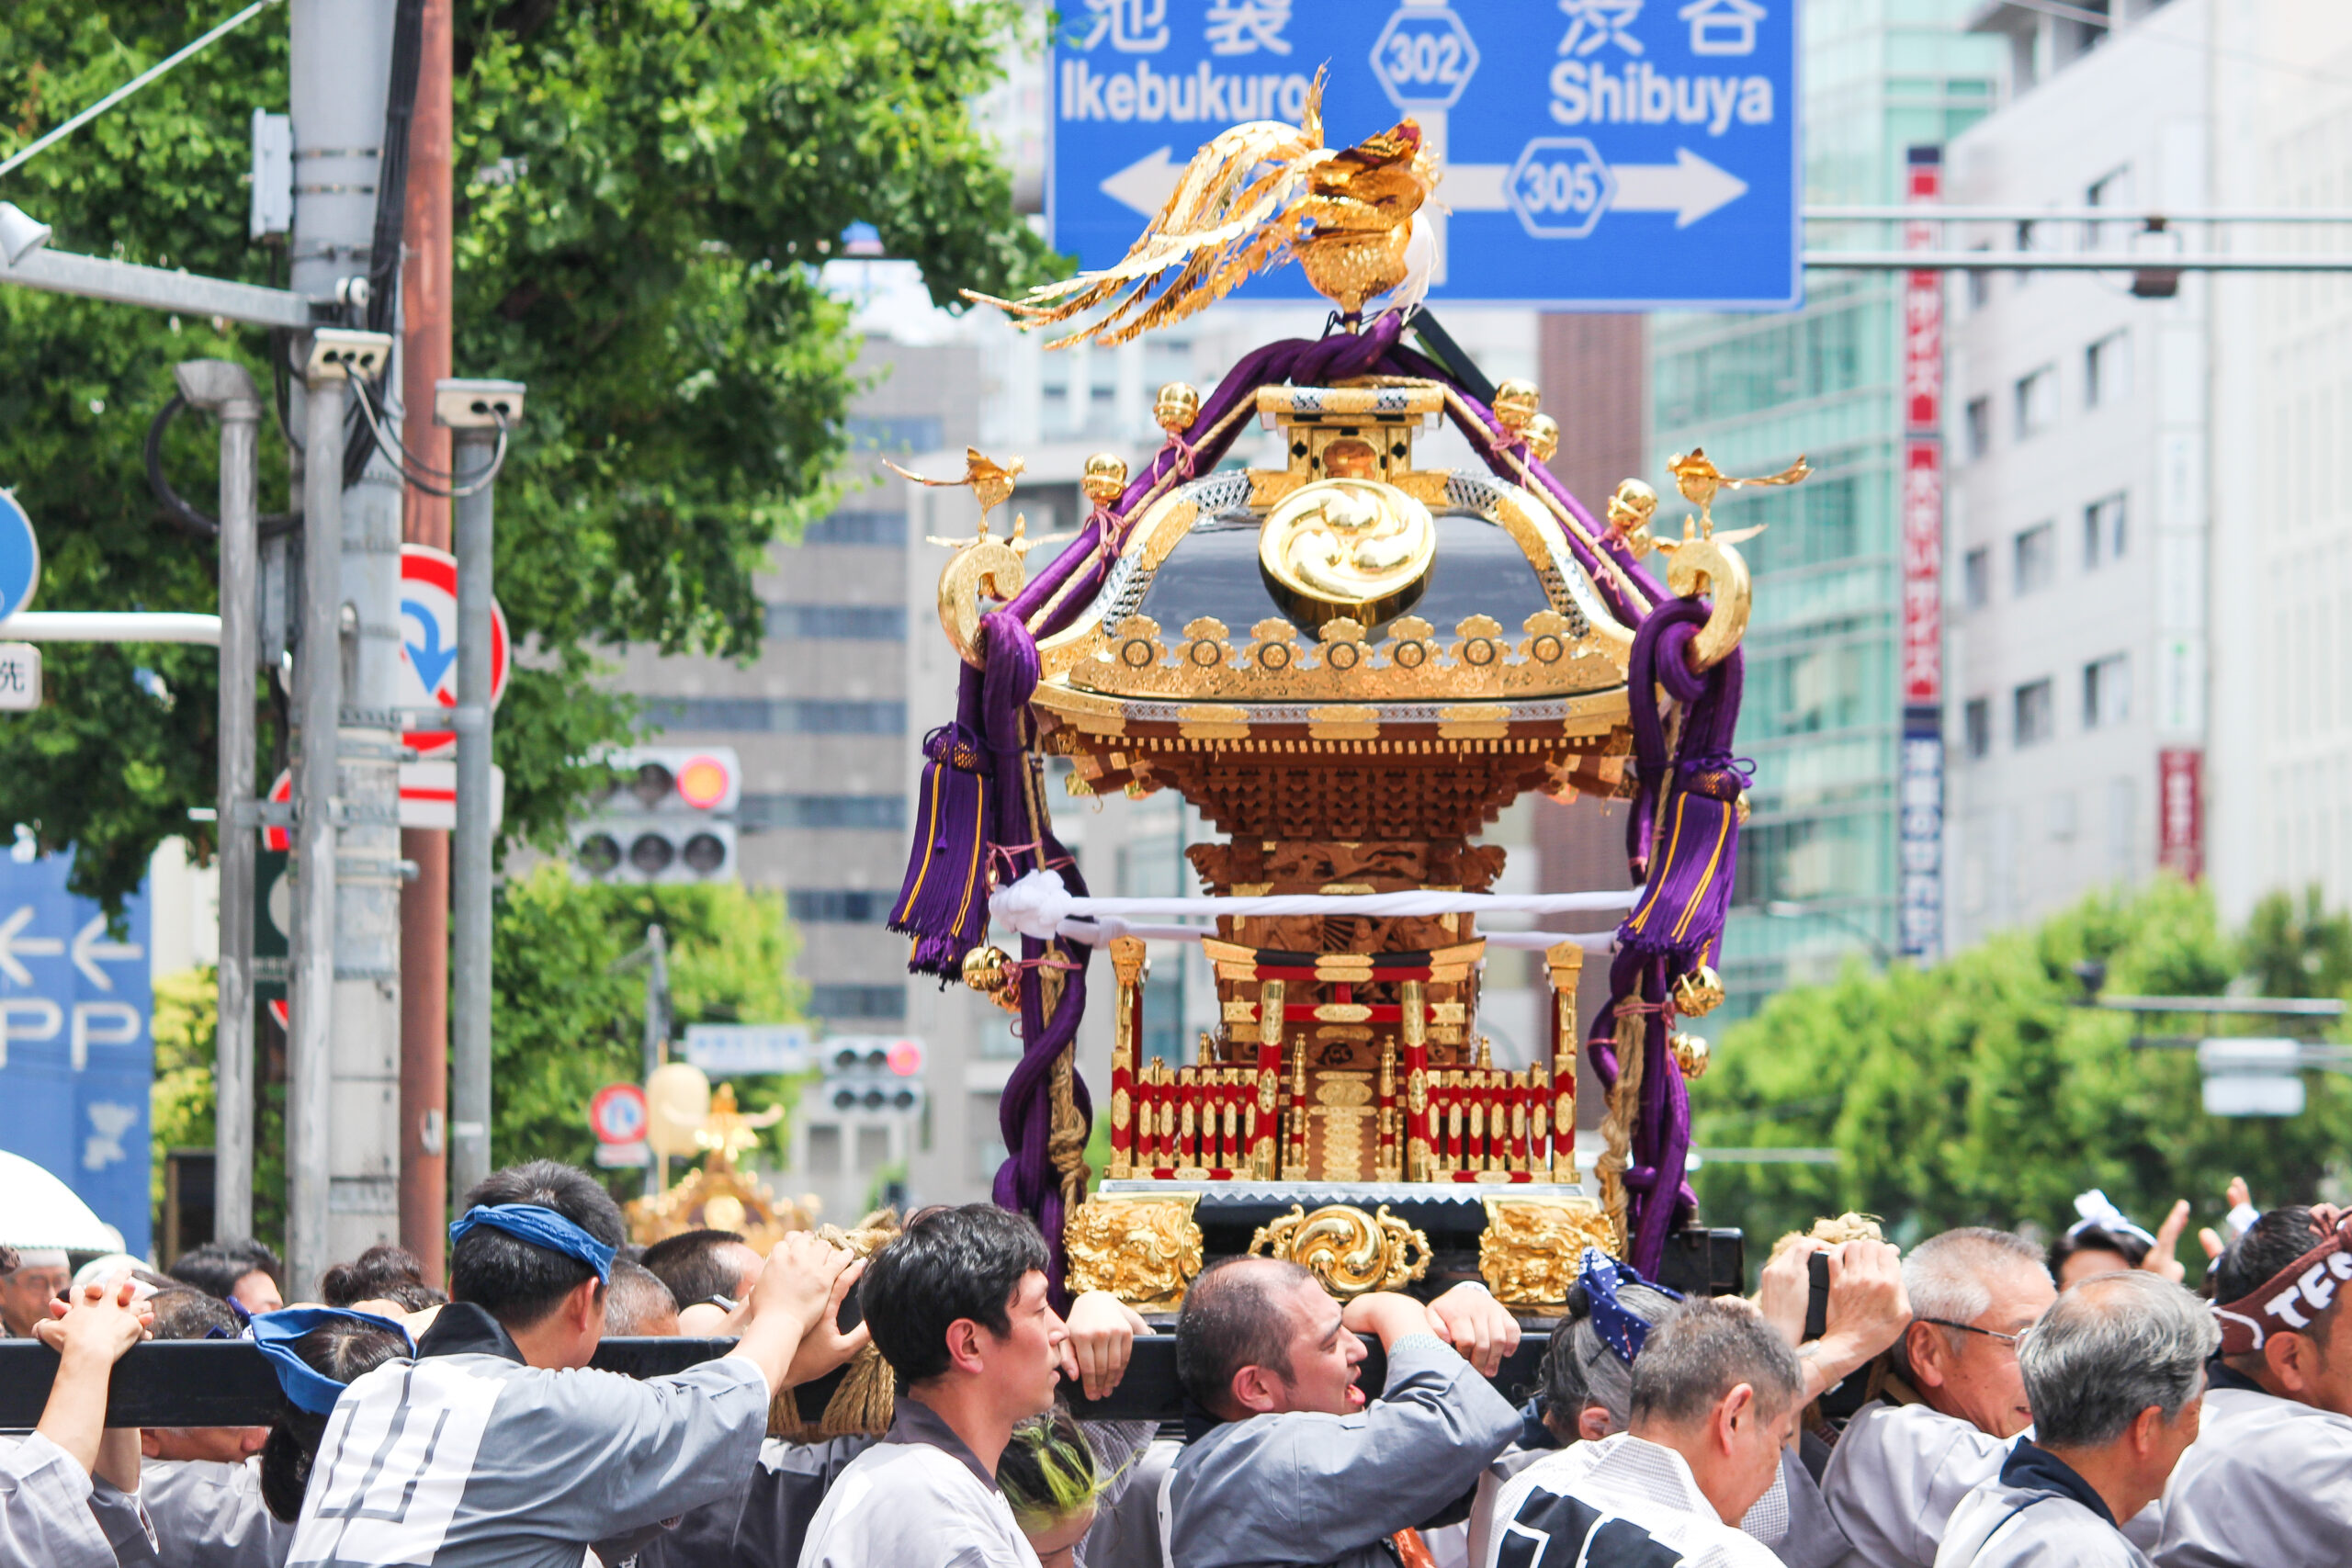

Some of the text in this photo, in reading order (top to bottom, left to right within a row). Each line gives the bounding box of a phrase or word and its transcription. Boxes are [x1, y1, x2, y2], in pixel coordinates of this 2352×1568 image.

[1387, 31, 1462, 85] 302
[1061, 59, 1308, 121] Ikebukuro
[1548, 59, 1774, 135] Shibuya
[1522, 162, 1597, 213] 305
